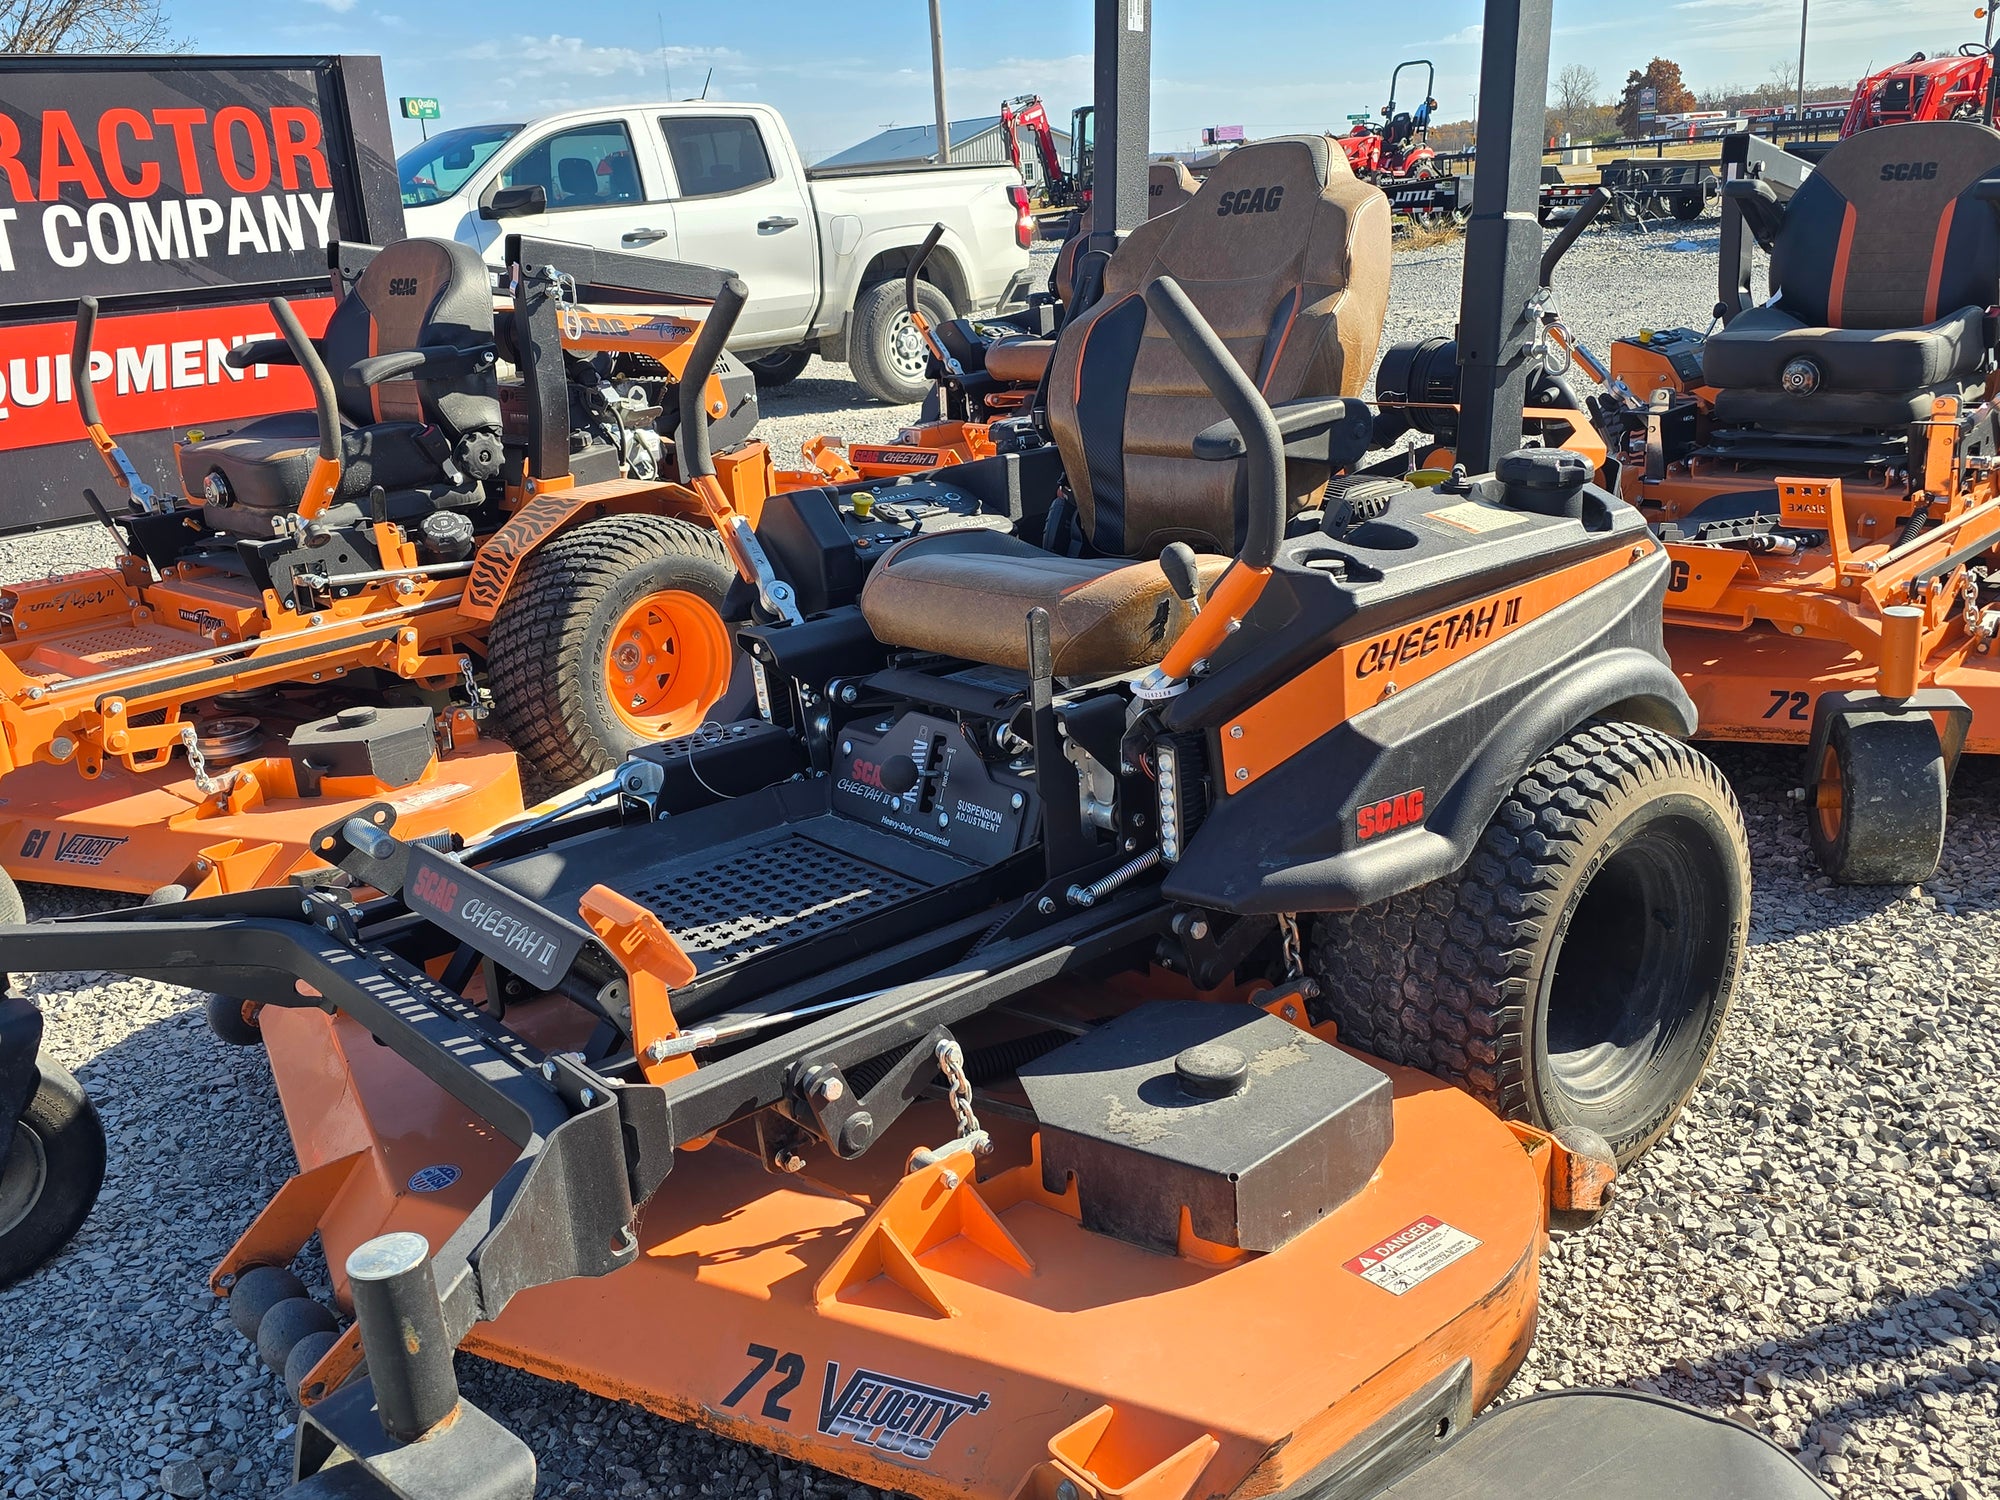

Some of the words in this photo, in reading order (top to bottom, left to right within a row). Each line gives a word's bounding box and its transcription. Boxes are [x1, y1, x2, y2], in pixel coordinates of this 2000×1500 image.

[1785, 109, 1845, 121] HRDWA
[1880, 162, 1938, 181] SCAG
[1149, 184, 1164, 197] AG
[1217, 186, 1285, 217] SCAG
[1395, 190, 1435, 202] LITTLE
[42, 191, 334, 268] COMPANY
[389, 278, 417, 296] SCAG
[567, 315, 631, 338] SCAG
[0, 332, 277, 420] UIPMENT
[854, 450, 879, 462] SCAG
[883, 453, 928, 464] CHEETAH
[928, 455, 937, 464] II
[1355, 599, 1500, 680] CHEETAH
[1501, 595, 1523, 628] II
[592, 671, 615, 731] MULTI
[1761, 690, 1810, 721] 72
[851, 758, 885, 788] SCA
[837, 777, 885, 803] CHEETAH
[882, 794, 891, 806] II
[954, 813, 1001, 833] ADJUSTMENT
[956, 799, 1003, 825] SUSPENSION
[1357, 790, 1424, 839] SCAG
[20, 829, 51, 858] 61
[54, 832, 129, 861] VELOCITY
[880, 814, 914, 835] Heavy-Duty
[914, 826, 951, 847] Commercial
[60, 853, 104, 866] PLUS
[412, 866, 459, 913] SCAG
[461, 898, 544, 959] CHEETAH
[537, 942, 557, 966] II
[1702, 921, 1742, 995] SUPER
[1374, 1221, 1435, 1258] DANGER
[720, 1343, 806, 1422] 72
[816, 1360, 991, 1441] VELOCITY
[828, 1417, 937, 1460] PLUS
